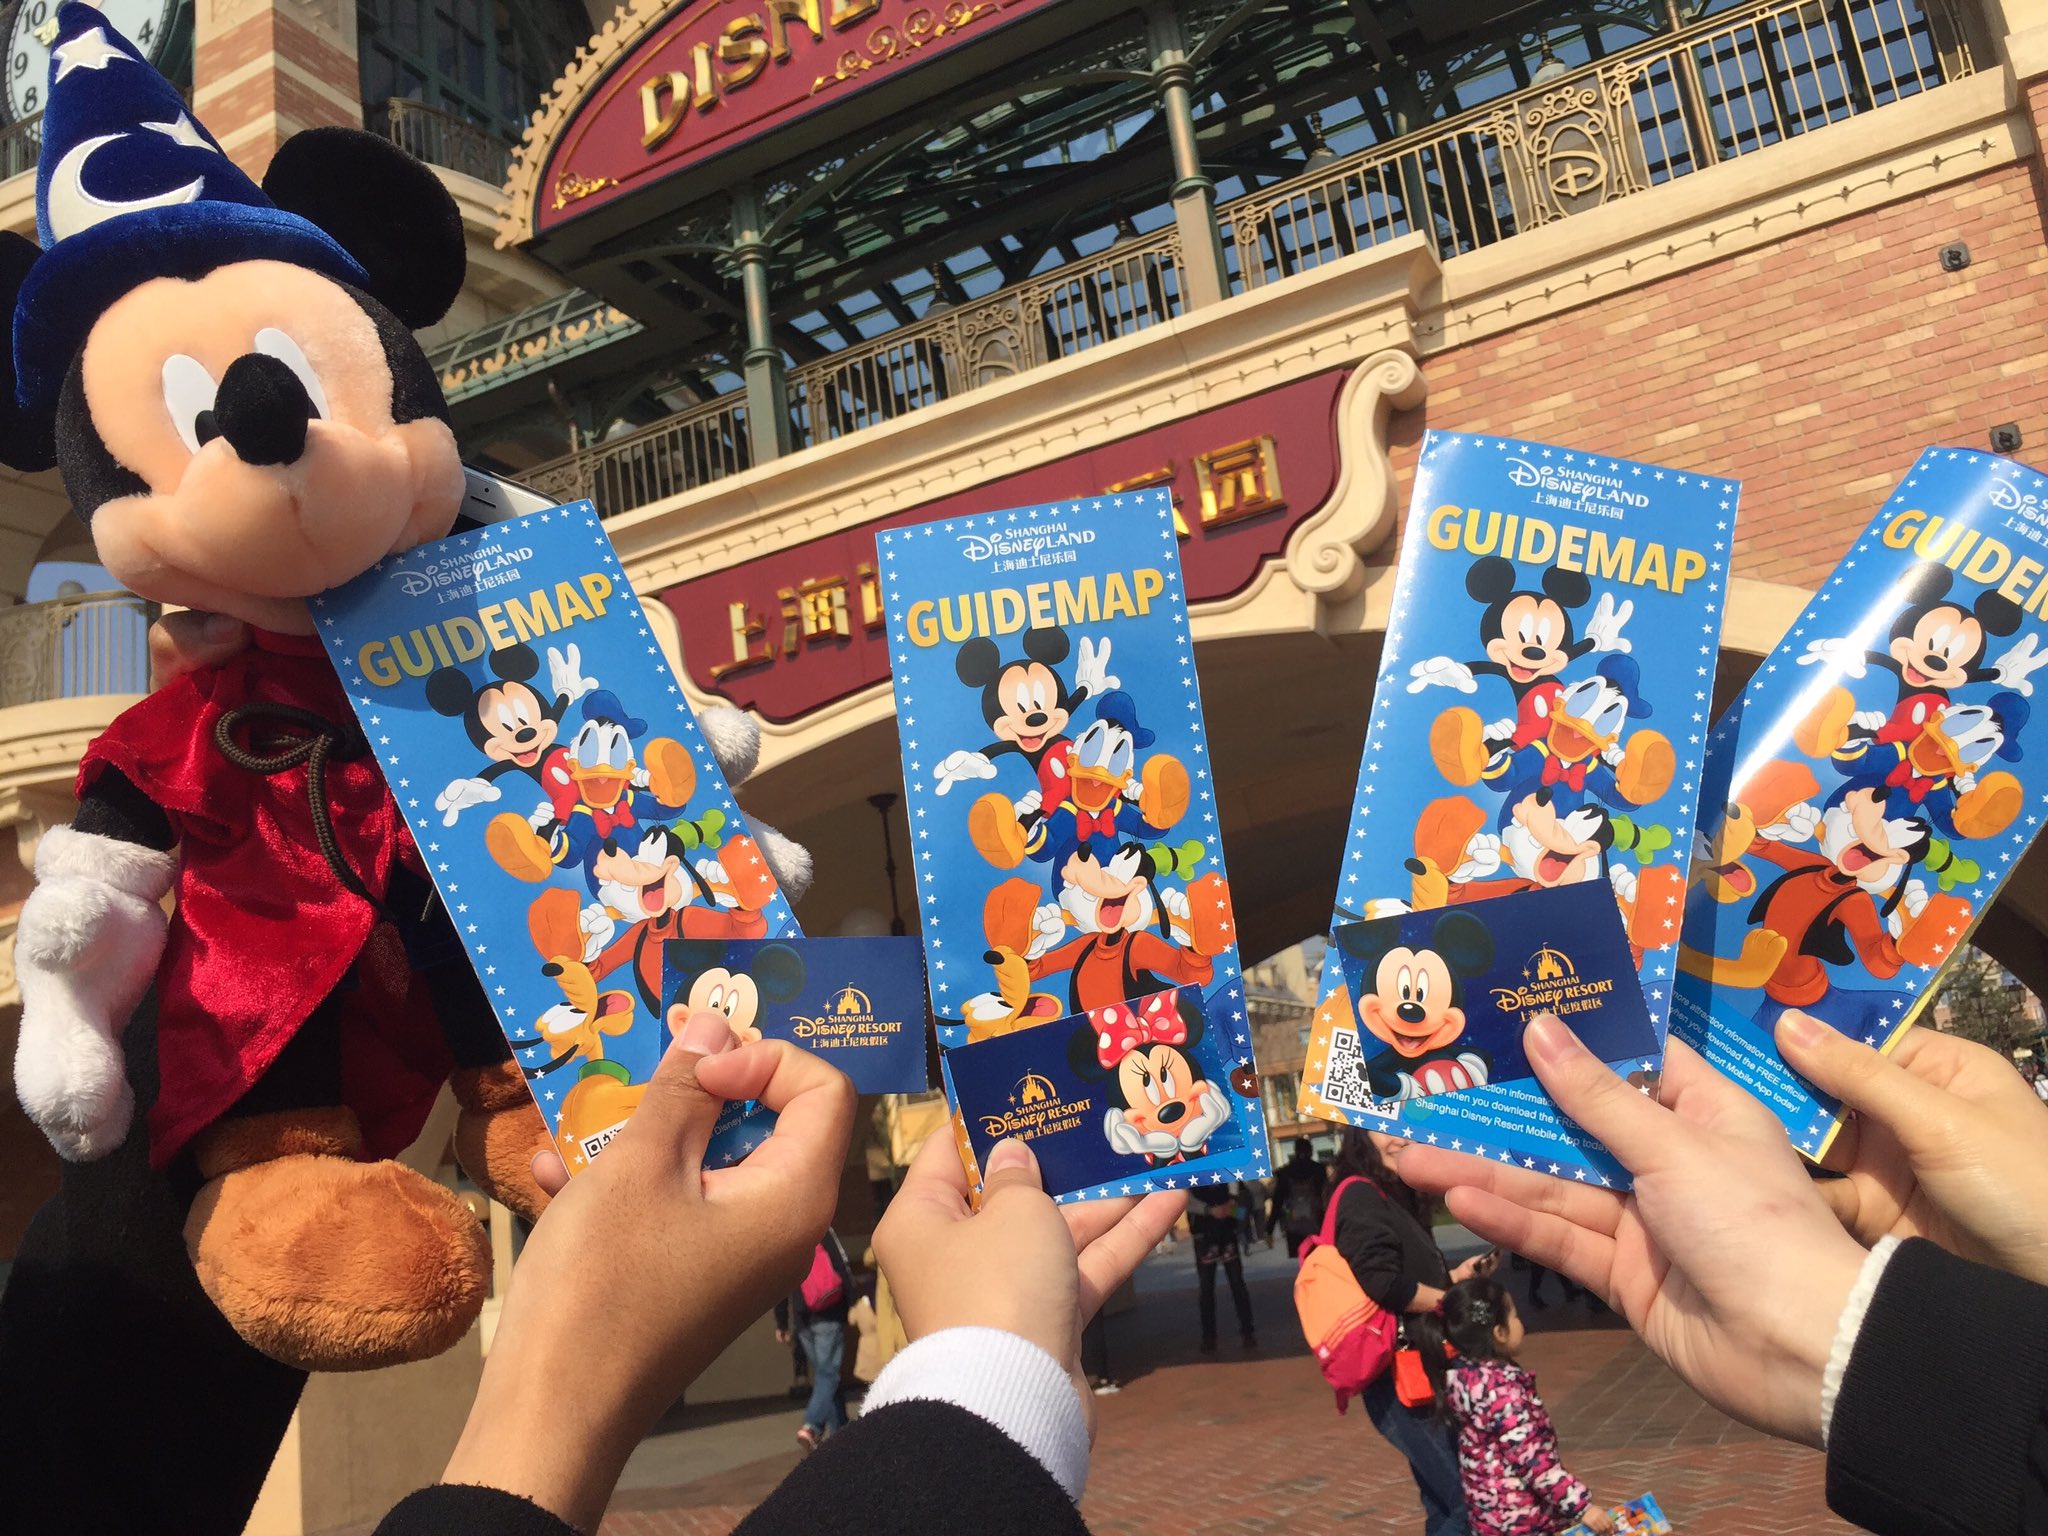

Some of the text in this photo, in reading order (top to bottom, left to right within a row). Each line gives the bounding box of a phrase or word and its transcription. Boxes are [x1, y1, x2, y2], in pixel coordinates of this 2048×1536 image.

[23, 1, 47, 34] 10
[138, 18, 153, 44] 4
[14, 52, 28, 80] 9
[23, 86, 37, 113] 8
[1505, 457, 1649, 508] DISNEYLAND
[1557, 466, 1623, 489] SHANGHAI
[1531, 492, 1624, 520] 上海迪士尼乐园
[1005, 522, 1067, 540] SHANGHAI
[440, 544, 502, 569] SHANGHAI
[956, 530, 1096, 562] DISNEYLAND
[1426, 504, 1706, 594] GUIDEMAP
[390, 547, 533, 597] DISNEYLAND
[991, 550, 1077, 574] 上海迪士尼乐园
[436, 568, 521, 606] 上海迪士尼乐园
[906, 568, 1165, 647] GUIDEMAP
[358, 572, 613, 687] GUIDEMAP
[1489, 979, 1613, 1012] DISNEY RESORT
[1530, 976, 1580, 992] SHANGHAI
[790, 1016, 902, 1039] DISNEY RESORT
[828, 1014, 874, 1023] SHANGHAI
[810, 1036, 889, 1048] 上海迪士尼度假区
[1690, 1003, 1725, 1031] attraction
[1724, 1027, 1766, 1060] information
[1766, 1057, 1784, 1072] and
[1673, 1025, 1700, 1049] Disney
[1700, 1044, 1727, 1068] Resort
[1726, 1062, 1754, 1085] Mobile
[1753, 1081, 1773, 1097] App
[1772, 1092, 1800, 1114] today!
[1687, 1019, 1704, 1035] you
[1704, 1031, 1743, 1061] download
[1742, 1056, 1756, 1070] the
[1756, 1066, 1781, 1086] FREE
[1780, 1083, 1808, 1103] official
[979, 1098, 1091, 1137] DISNEY RESORT
[1015, 1098, 1061, 1116] SHANGHAI
[1472, 1096, 1490, 1107] you
[1491, 1101, 1537, 1119] download
[1539, 1112, 1554, 1124] the
[714, 1115, 742, 1136] Disney
[1006, 1115, 1082, 1142] 海迪士尼度假区
[1415, 1098, 1459, 1116] Shanghai
[1461, 1109, 1492, 1127] Disney
[1493, 1117, 1524, 1133] Resort
[1525, 1125, 1557, 1141] Mobile
[1559, 1133, 1580, 1148] App
